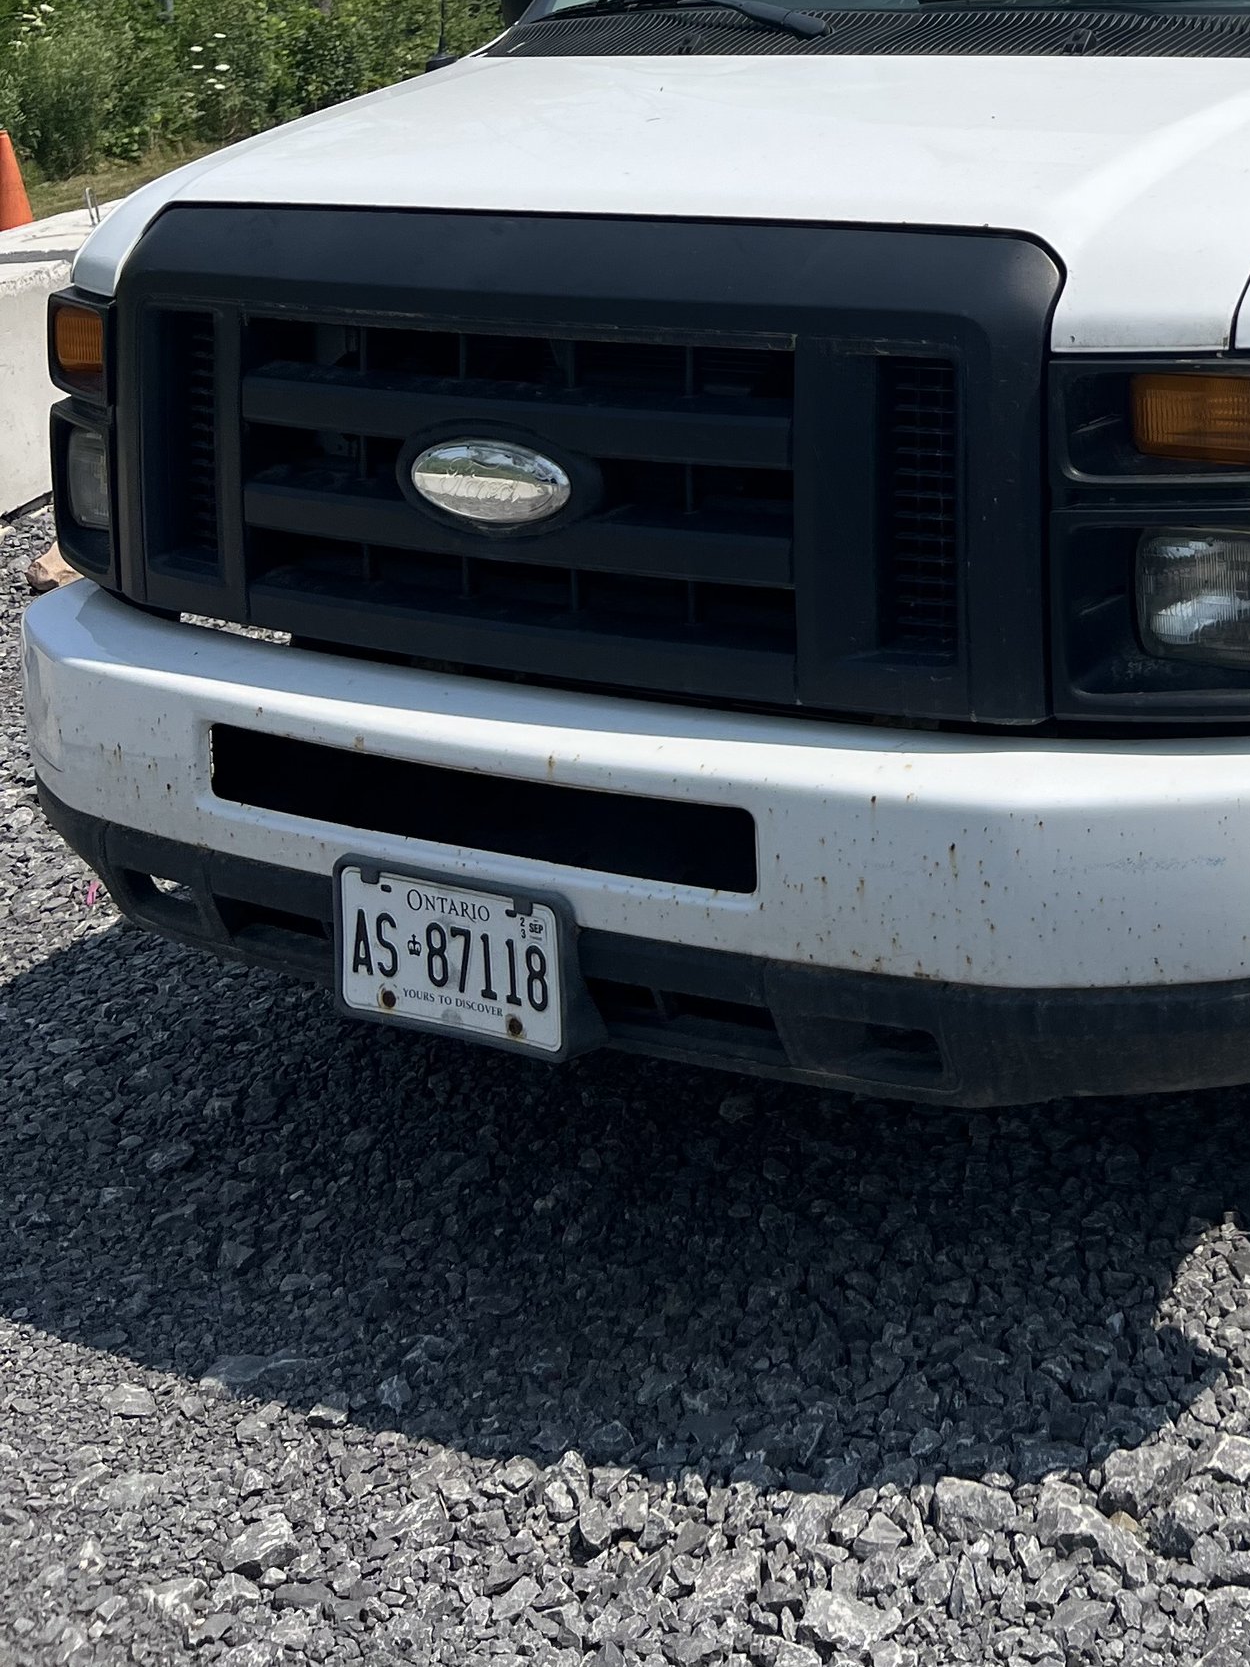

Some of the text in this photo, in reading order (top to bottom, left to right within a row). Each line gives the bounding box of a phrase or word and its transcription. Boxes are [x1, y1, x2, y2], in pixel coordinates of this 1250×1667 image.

[528, 922, 544, 934] SEP
[352, 908, 548, 1012] AS 87118
[403, 987, 503, 1017] YOURS TO DISCOVER
